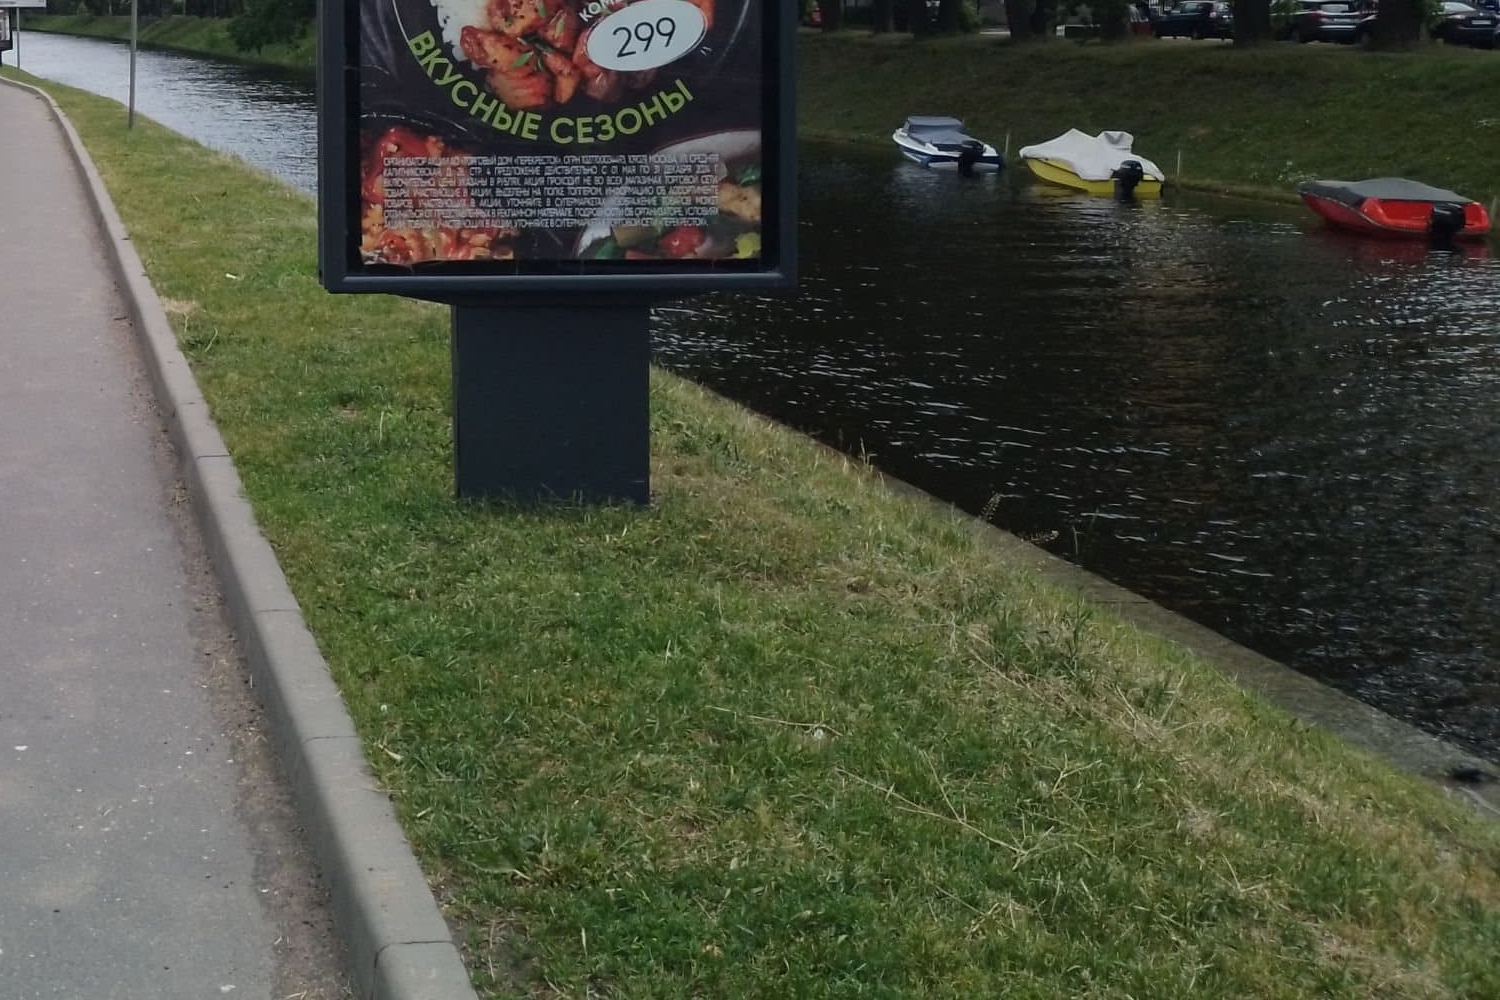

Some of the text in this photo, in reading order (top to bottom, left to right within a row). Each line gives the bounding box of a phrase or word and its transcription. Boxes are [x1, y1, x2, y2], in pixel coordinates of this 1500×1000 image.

[612, 17, 676, 58] 299
[409, 30, 693, 144] ВКУСНЫЕ СЕЗОНЫ
